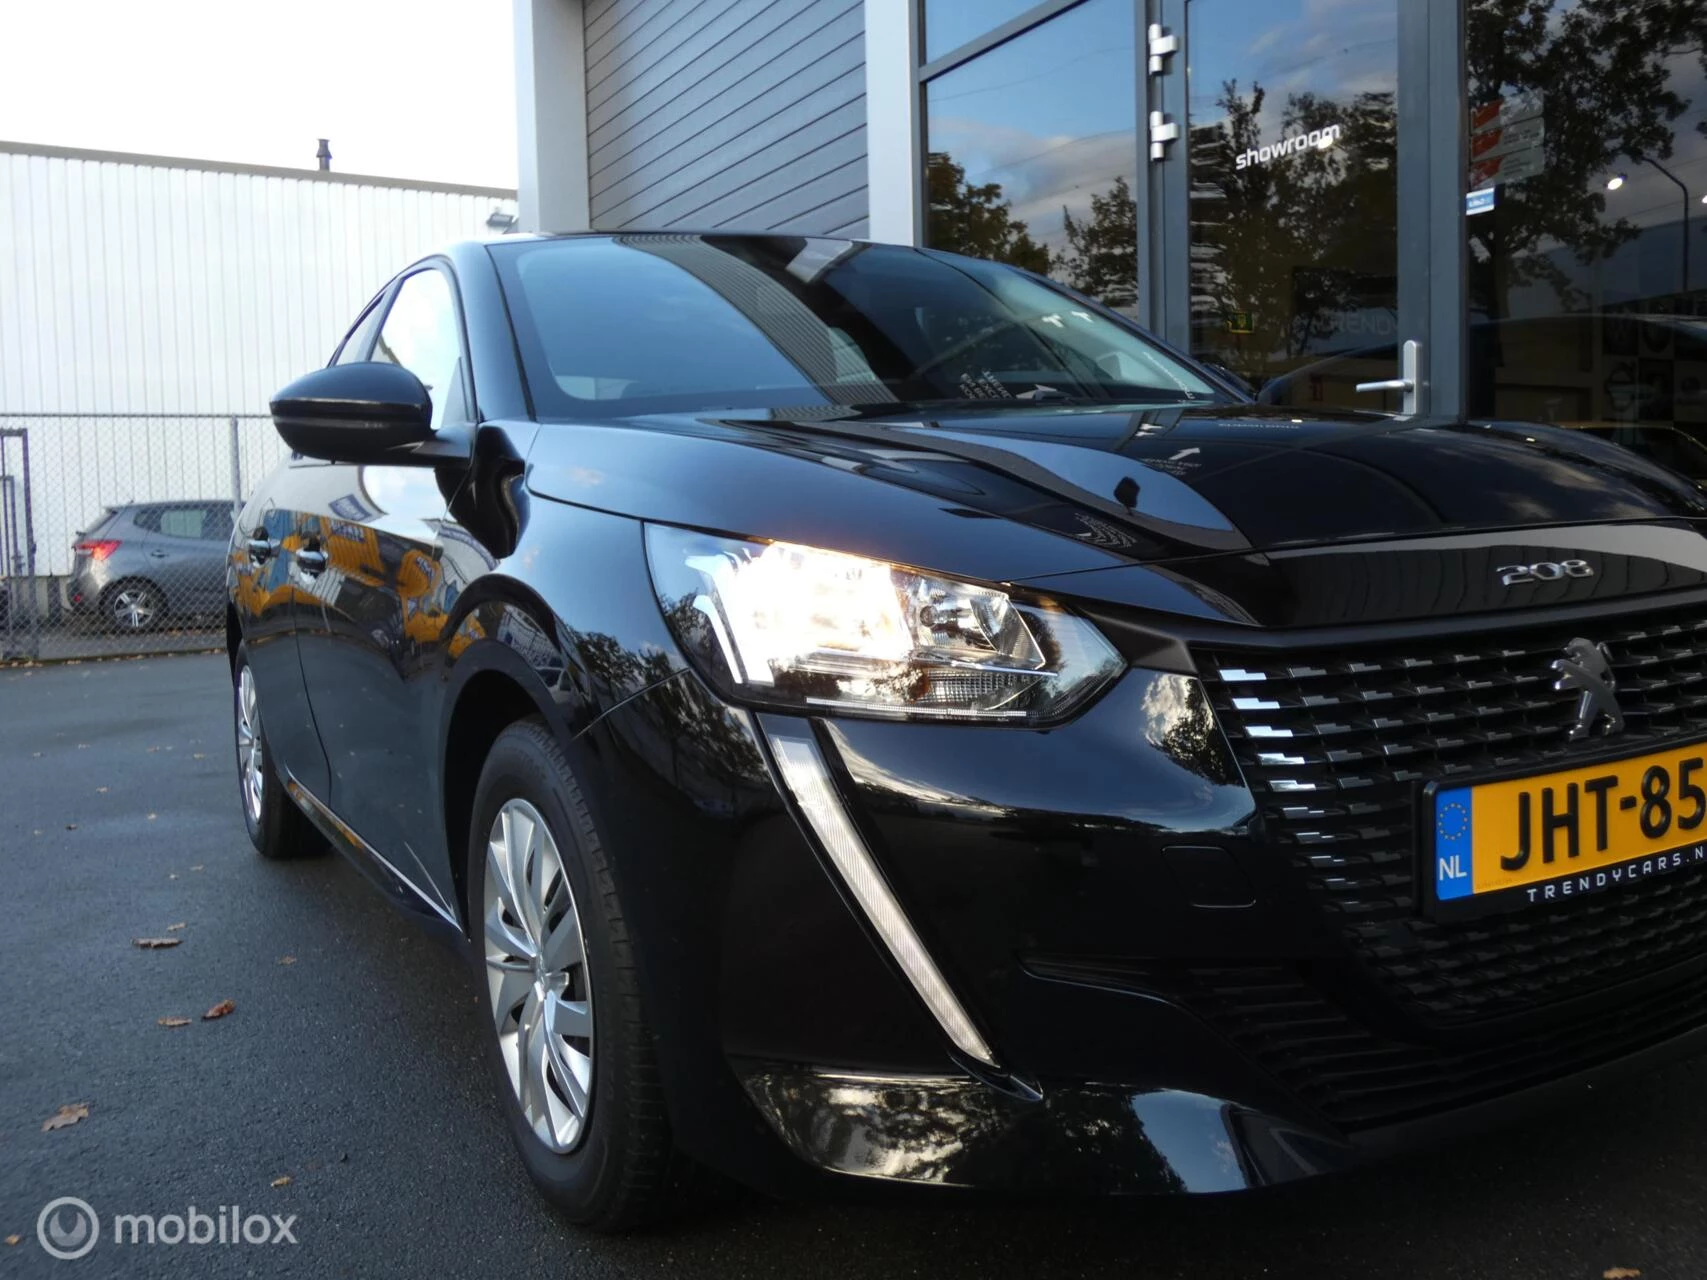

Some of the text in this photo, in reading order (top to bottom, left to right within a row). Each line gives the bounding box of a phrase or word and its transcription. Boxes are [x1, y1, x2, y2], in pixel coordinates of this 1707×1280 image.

[1235, 123, 1341, 171] showroom
[1497, 559, 1594, 586] 208
[1500, 757, 1706, 872] JHT-85
[1438, 855, 1468, 881] NL
[1527, 846, 1704, 902] TRENDYCARS.N
